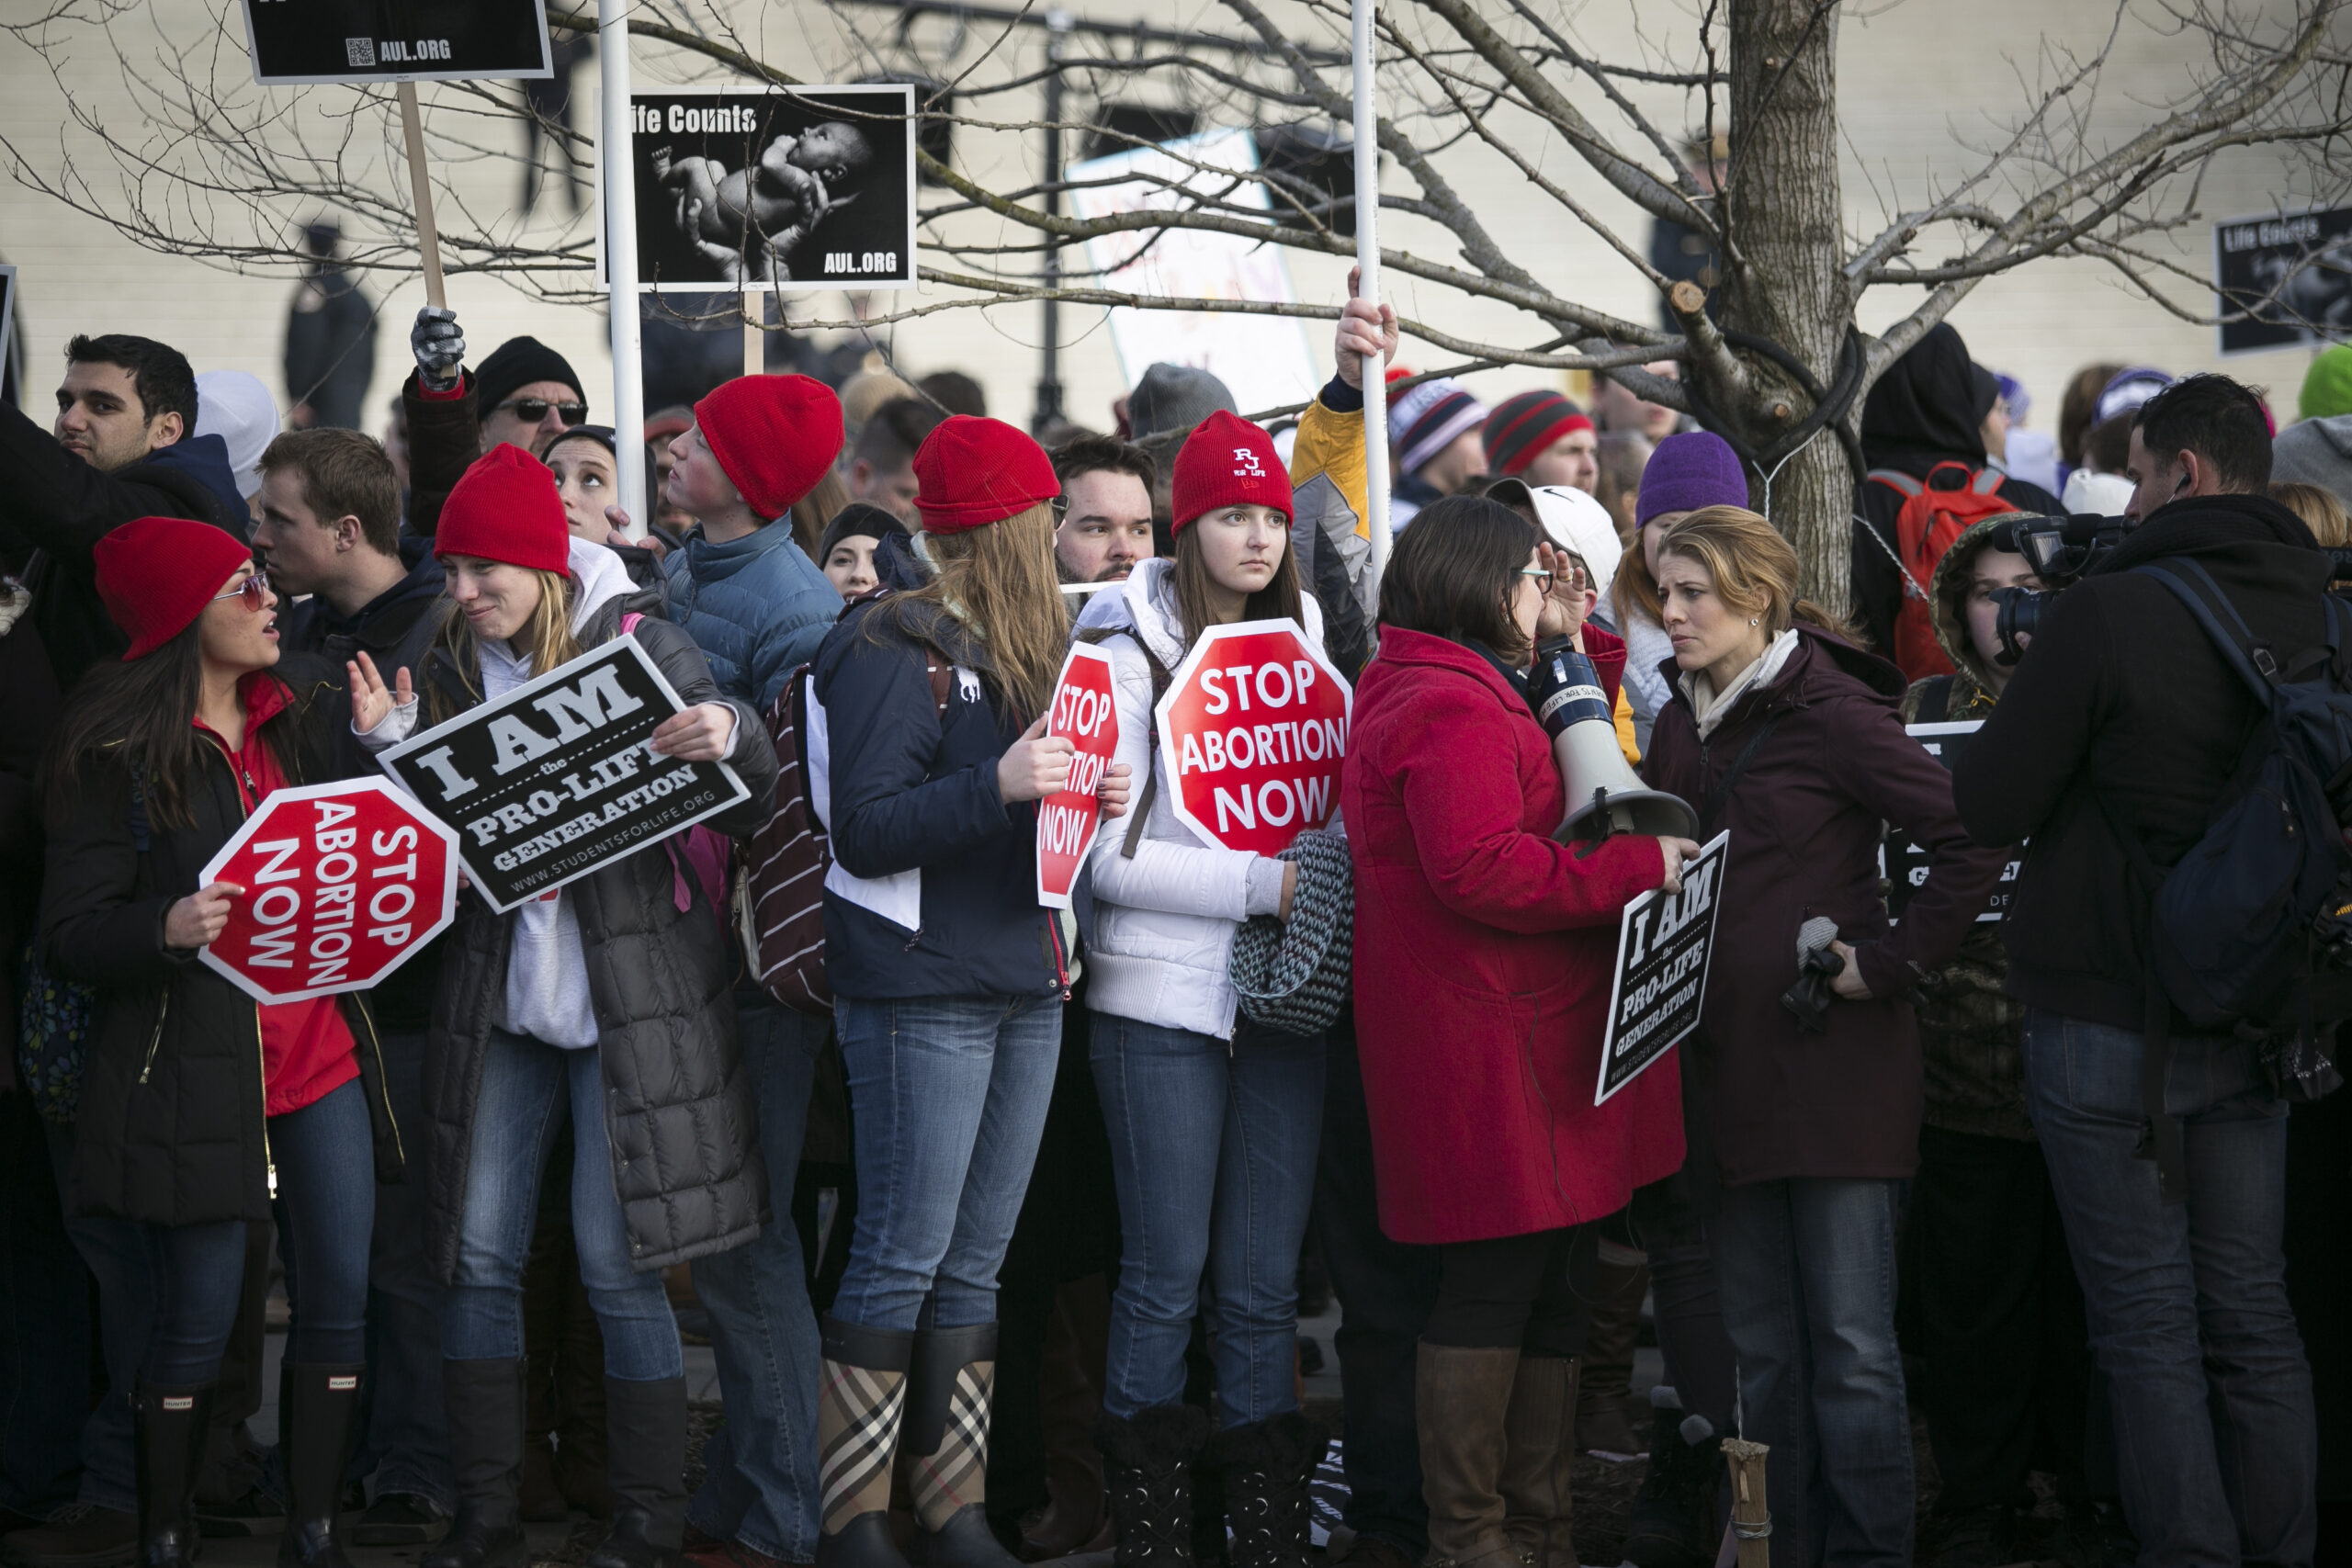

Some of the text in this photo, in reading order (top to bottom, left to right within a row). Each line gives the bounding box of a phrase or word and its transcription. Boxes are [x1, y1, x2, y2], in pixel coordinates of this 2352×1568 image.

[380, 39, 451, 62] AUL.ORG
[631, 104, 757, 134] ife Counts
[824, 252, 897, 273] AUL.ORG
[2224, 226, 2256, 253] Life
[1057, 683, 1111, 738] STOP
[1200, 660, 1316, 715] STOP
[415, 663, 644, 802] I AM
[1181, 717, 1346, 775] ABORTION
[540, 756, 568, 775] the
[493, 764, 698, 872] GENERATION
[1042, 804, 1088, 856] NOW
[1214, 775, 1330, 833] NOW
[511, 790, 716, 894] WWW.STUDENTSFORLIFE.ORG
[248, 838, 300, 968] NOW
[307, 801, 357, 987] ABORTION
[368, 825, 418, 946] STOP
[1629, 856, 1717, 970] I AM
[1620, 937, 1705, 1026] PRO-LIFE
[1615, 976, 1699, 1057] GENERATION
